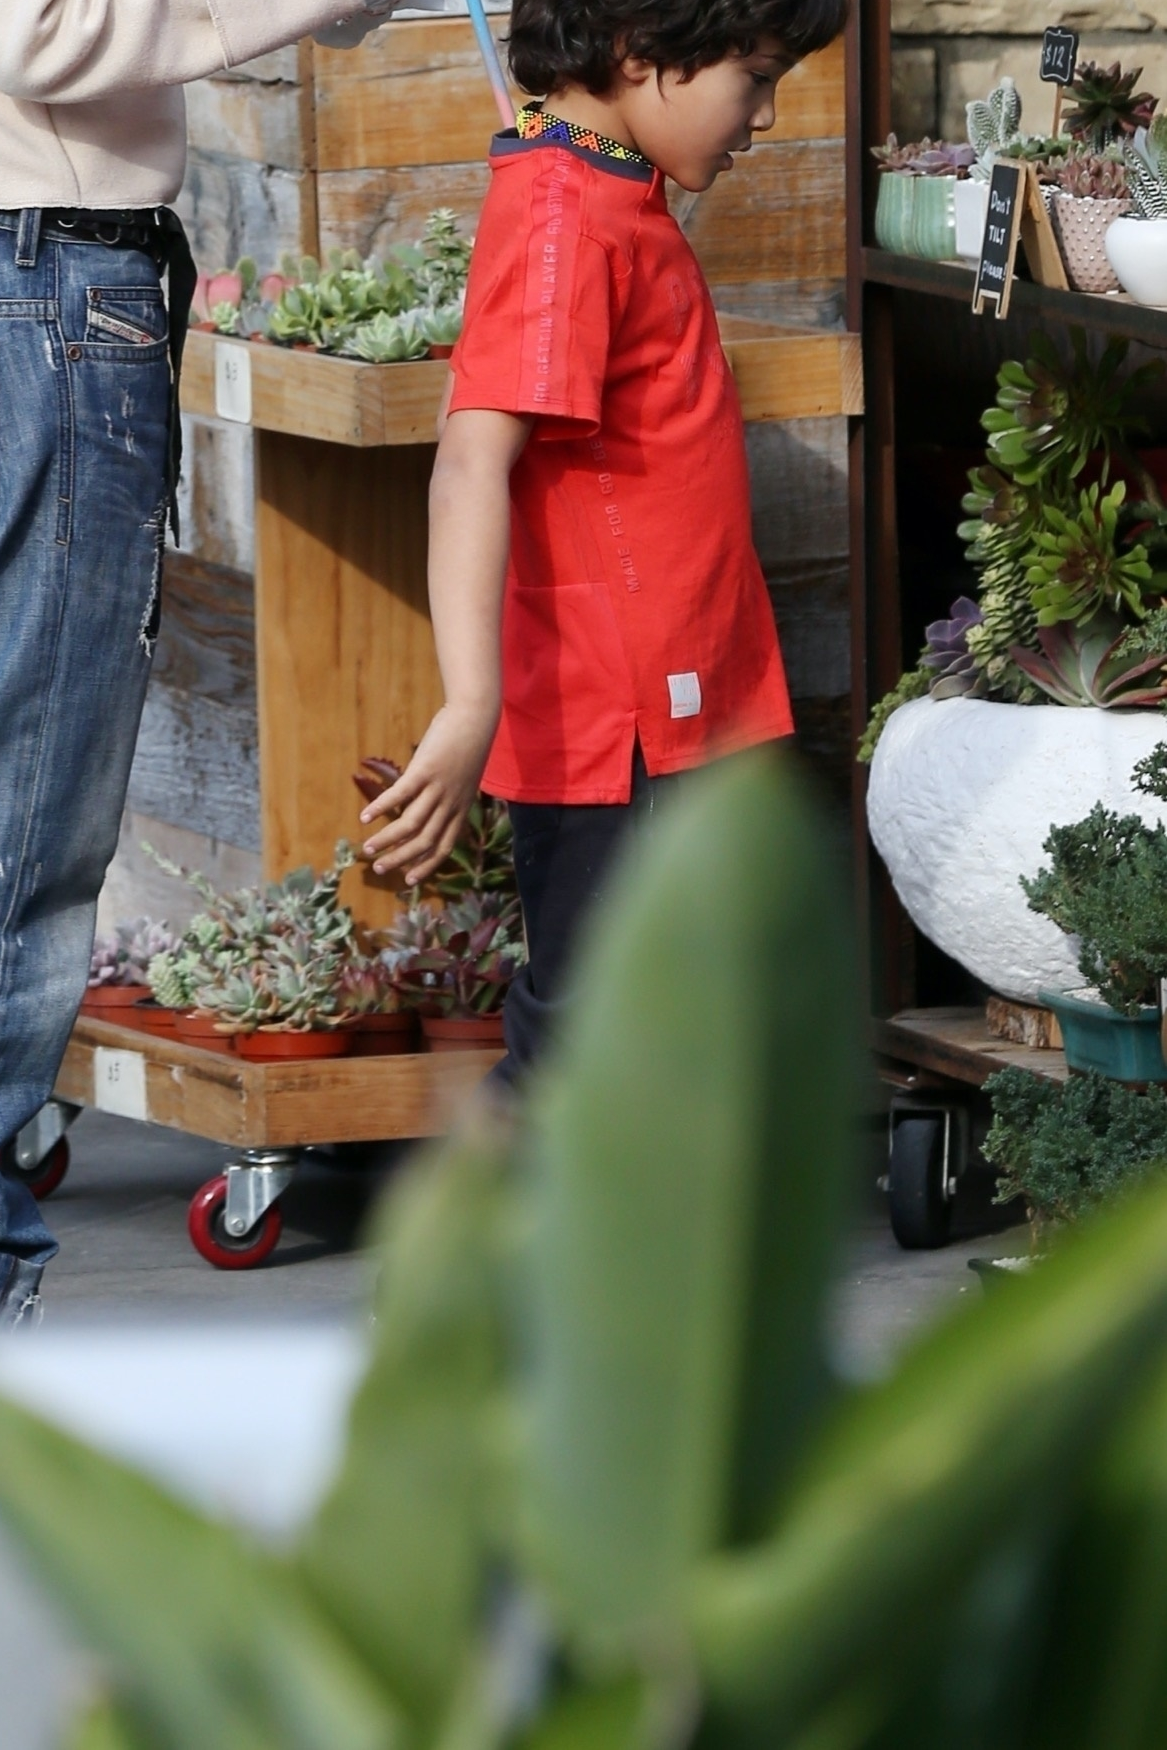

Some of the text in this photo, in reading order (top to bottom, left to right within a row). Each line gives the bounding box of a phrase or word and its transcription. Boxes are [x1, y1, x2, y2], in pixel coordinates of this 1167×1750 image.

[1045, 44, 1065, 68] $12
[546, 217, 563, 235] GO
[988, 224, 1006, 246] TILT
[540, 243, 558, 304] PLAYER
[532, 381, 548, 404] GO
[604, 504, 625, 538] FOR
[618, 546, 642, 593] MADE
